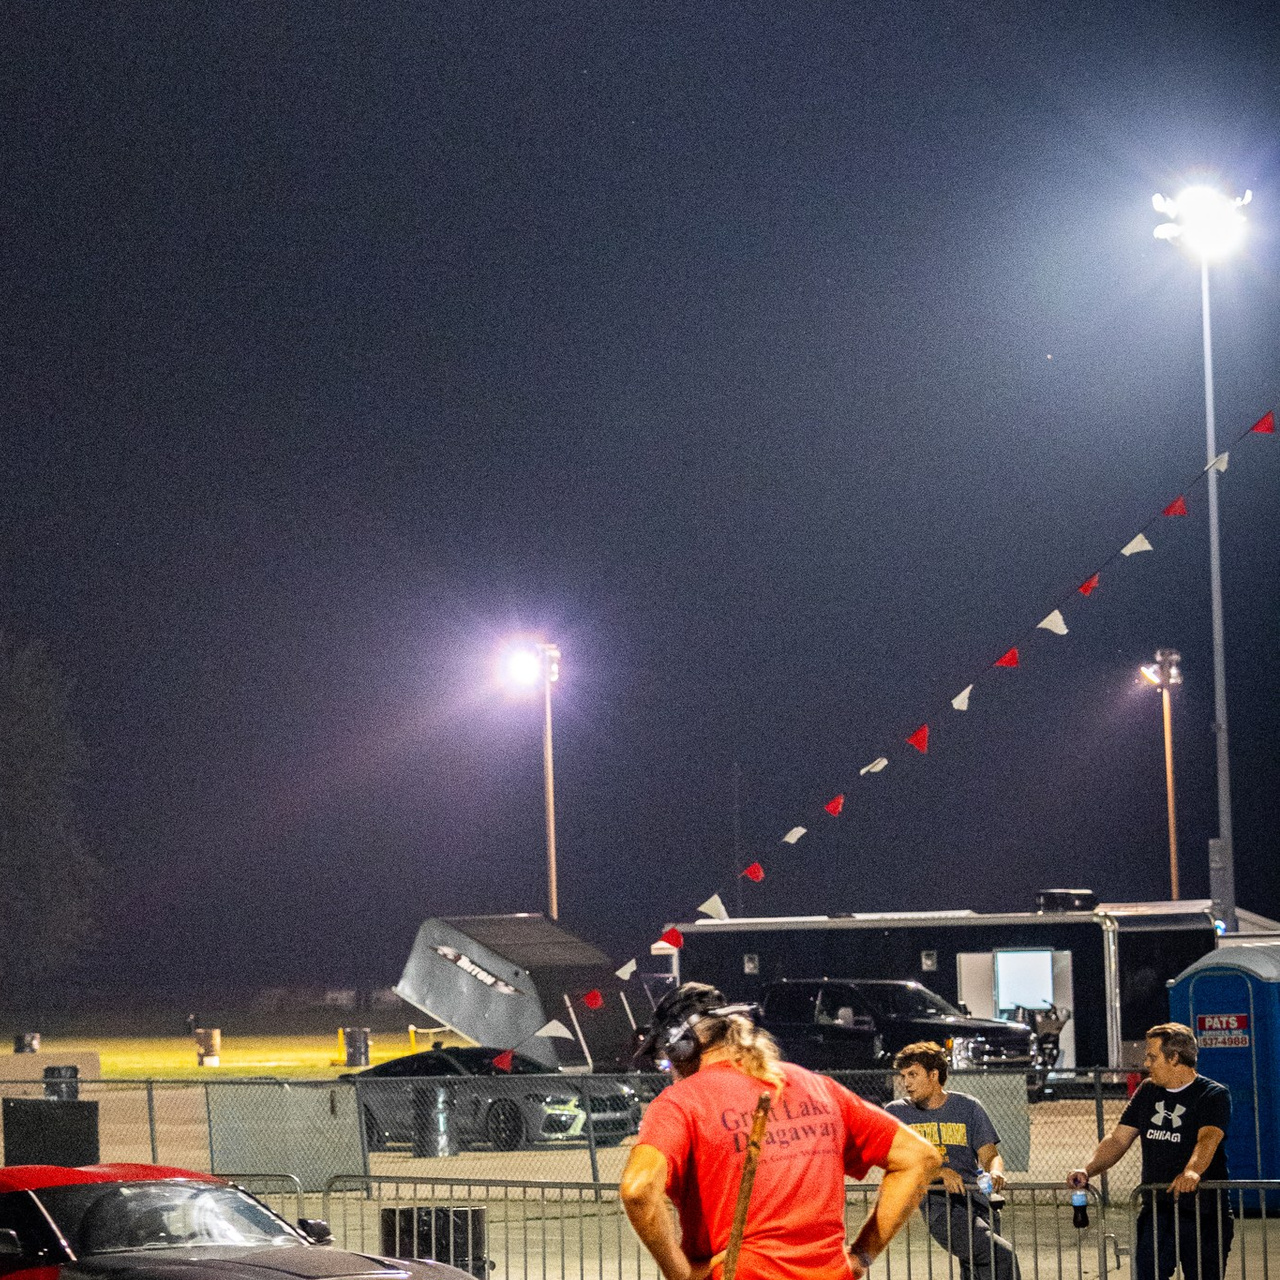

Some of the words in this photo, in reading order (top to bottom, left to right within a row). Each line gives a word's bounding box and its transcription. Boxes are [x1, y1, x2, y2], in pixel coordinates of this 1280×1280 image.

[1205, 1016, 1238, 1029] PATS
[721, 1107, 779, 1131] Grt
[733, 1122, 838, 1153] Dagaway
